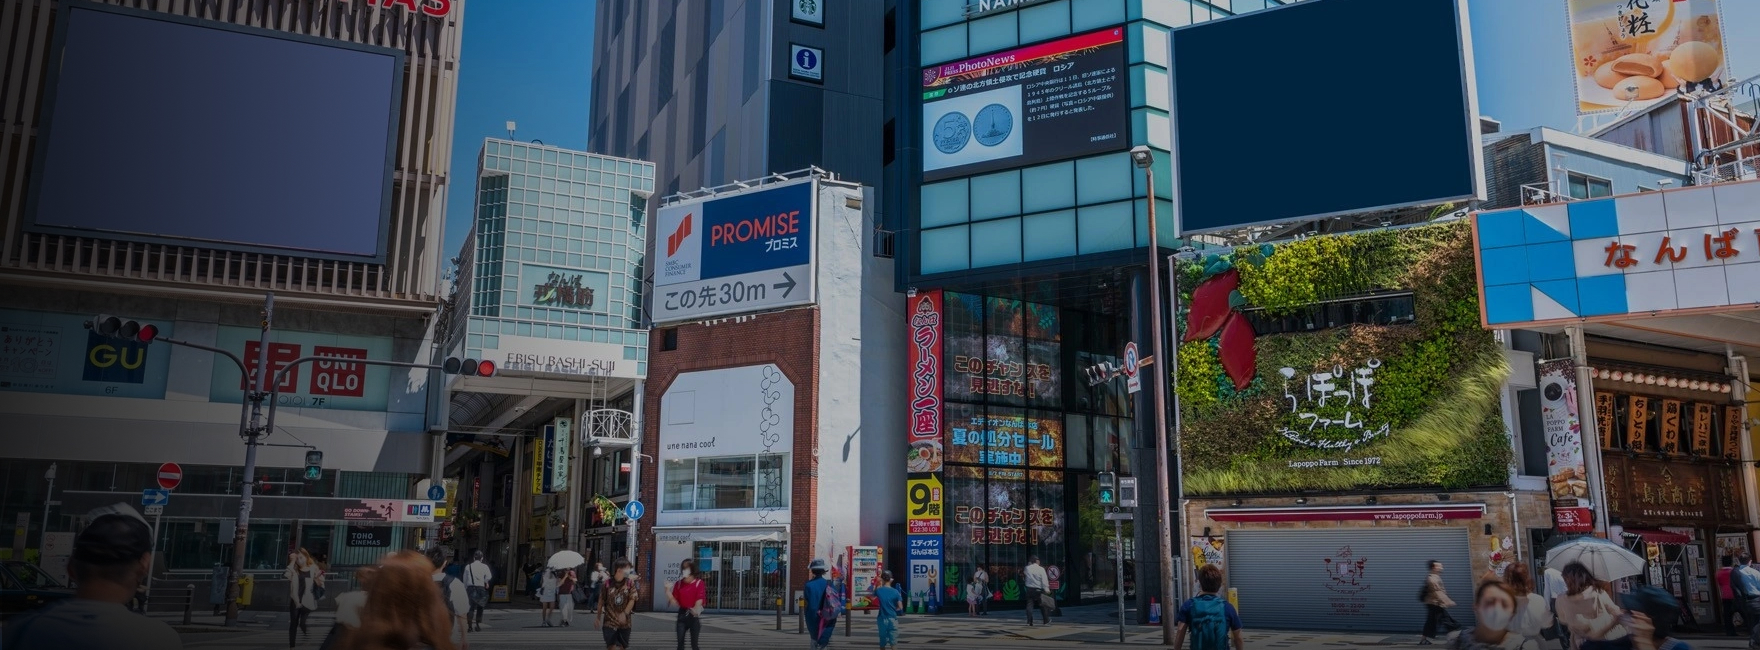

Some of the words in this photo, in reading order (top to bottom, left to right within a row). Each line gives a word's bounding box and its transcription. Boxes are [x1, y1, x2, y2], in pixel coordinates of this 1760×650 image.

[959, 54, 1015, 73] PhotoNews
[1053, 62, 1075, 73] ロシア
[711, 211, 799, 247] PROMISE
[765, 236, 798, 253] プロミス
[90, 344, 144, 370] GU
[507, 353, 545, 366] EBISU
[954, 356, 1050, 380] このチャンスを
[105, 386, 119, 395] 6F
[317, 372, 358, 391] QLO
[1280, 359, 1381, 413] らぽっぽ
[312, 398, 325, 406] 7F
[1299, 411, 1363, 431] ファーム
[667, 442, 680, 450] une
[681, 441, 698, 449] nana
[700, 437, 716, 448] cool
[952, 428, 1055, 450] 夏の処分セール
[1551, 432, 1573, 446] Cafe
[1289, 459, 1319, 468] Lapoppo
[1320, 459, 1339, 467] Farm
[1343, 458, 1363, 466] Since
[910, 483, 931, 516] 9
[955, 506, 1053, 526] このチャンスを
[1374, 512, 1443, 520] www.lapoppofarm.jp
